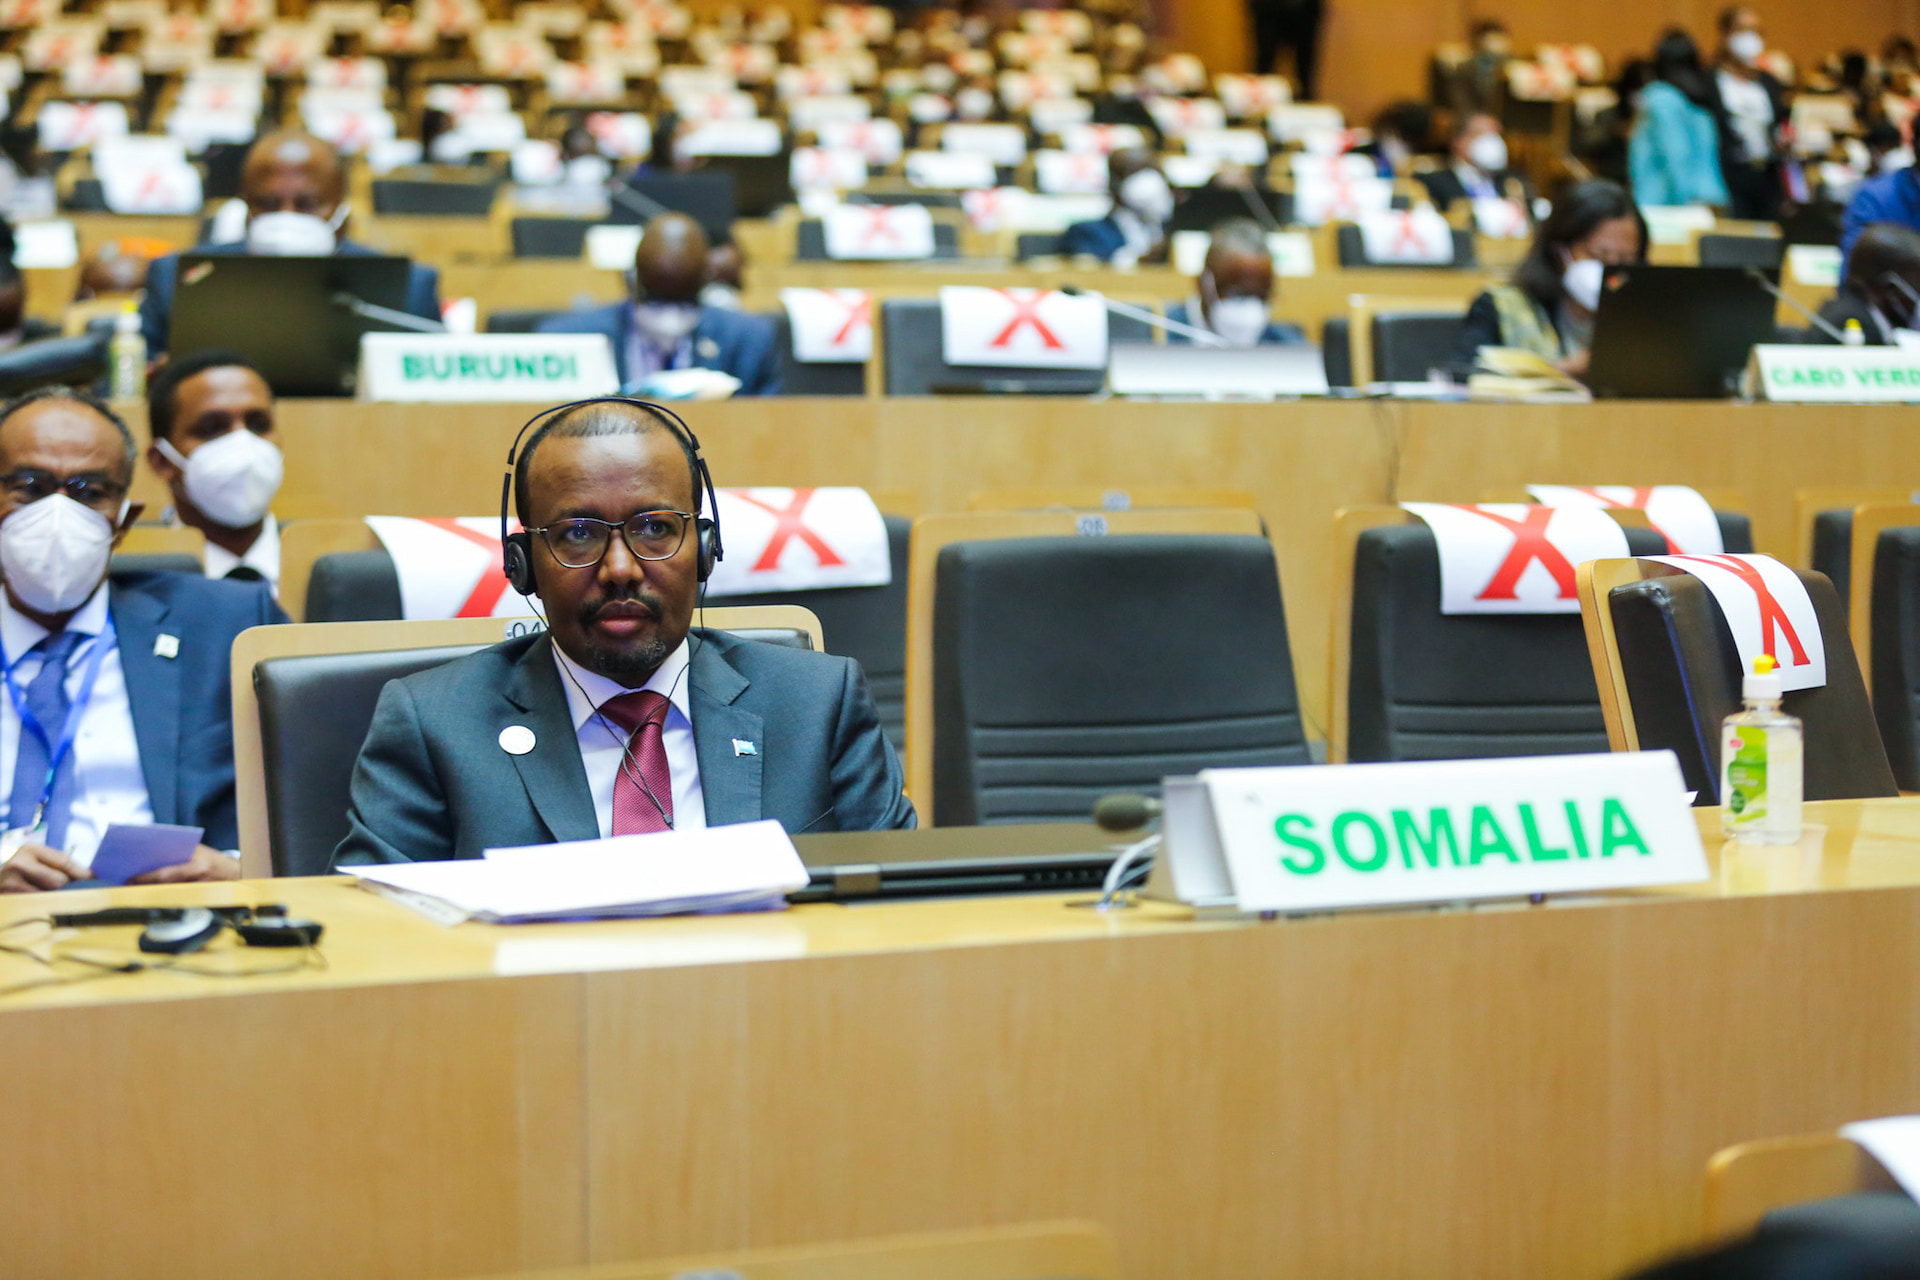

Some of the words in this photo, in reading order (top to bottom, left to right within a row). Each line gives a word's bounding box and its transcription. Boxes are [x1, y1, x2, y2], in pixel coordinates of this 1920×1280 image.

[402, 354, 579, 381] BURUNDI
[1771, 367, 1846, 388] CABO
[1273, 796, 1653, 877] SOMALIA
